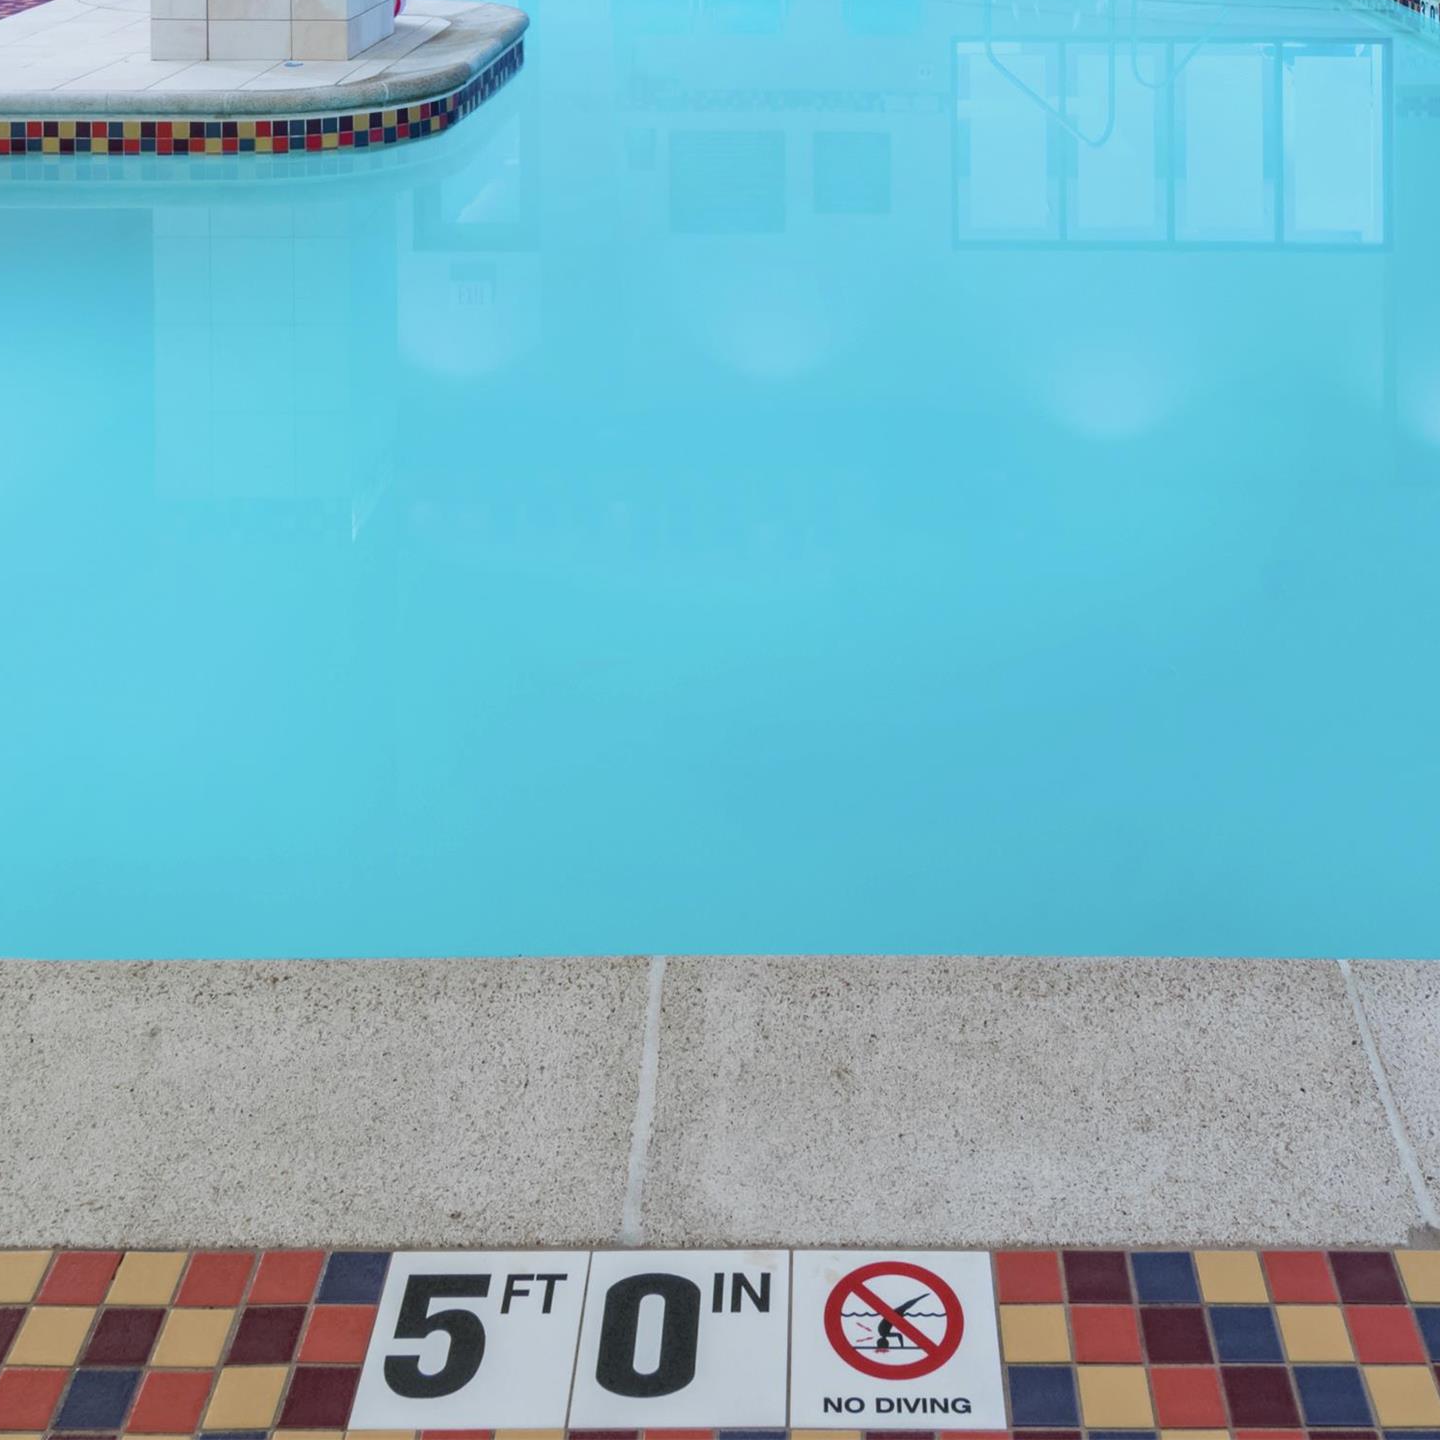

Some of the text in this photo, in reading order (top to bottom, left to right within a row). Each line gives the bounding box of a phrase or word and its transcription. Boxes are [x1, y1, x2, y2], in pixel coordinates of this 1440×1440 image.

[383, 1273, 772, 1399] 5 FT 0 IN
[823, 1396, 972, 1415] NO DIVING
